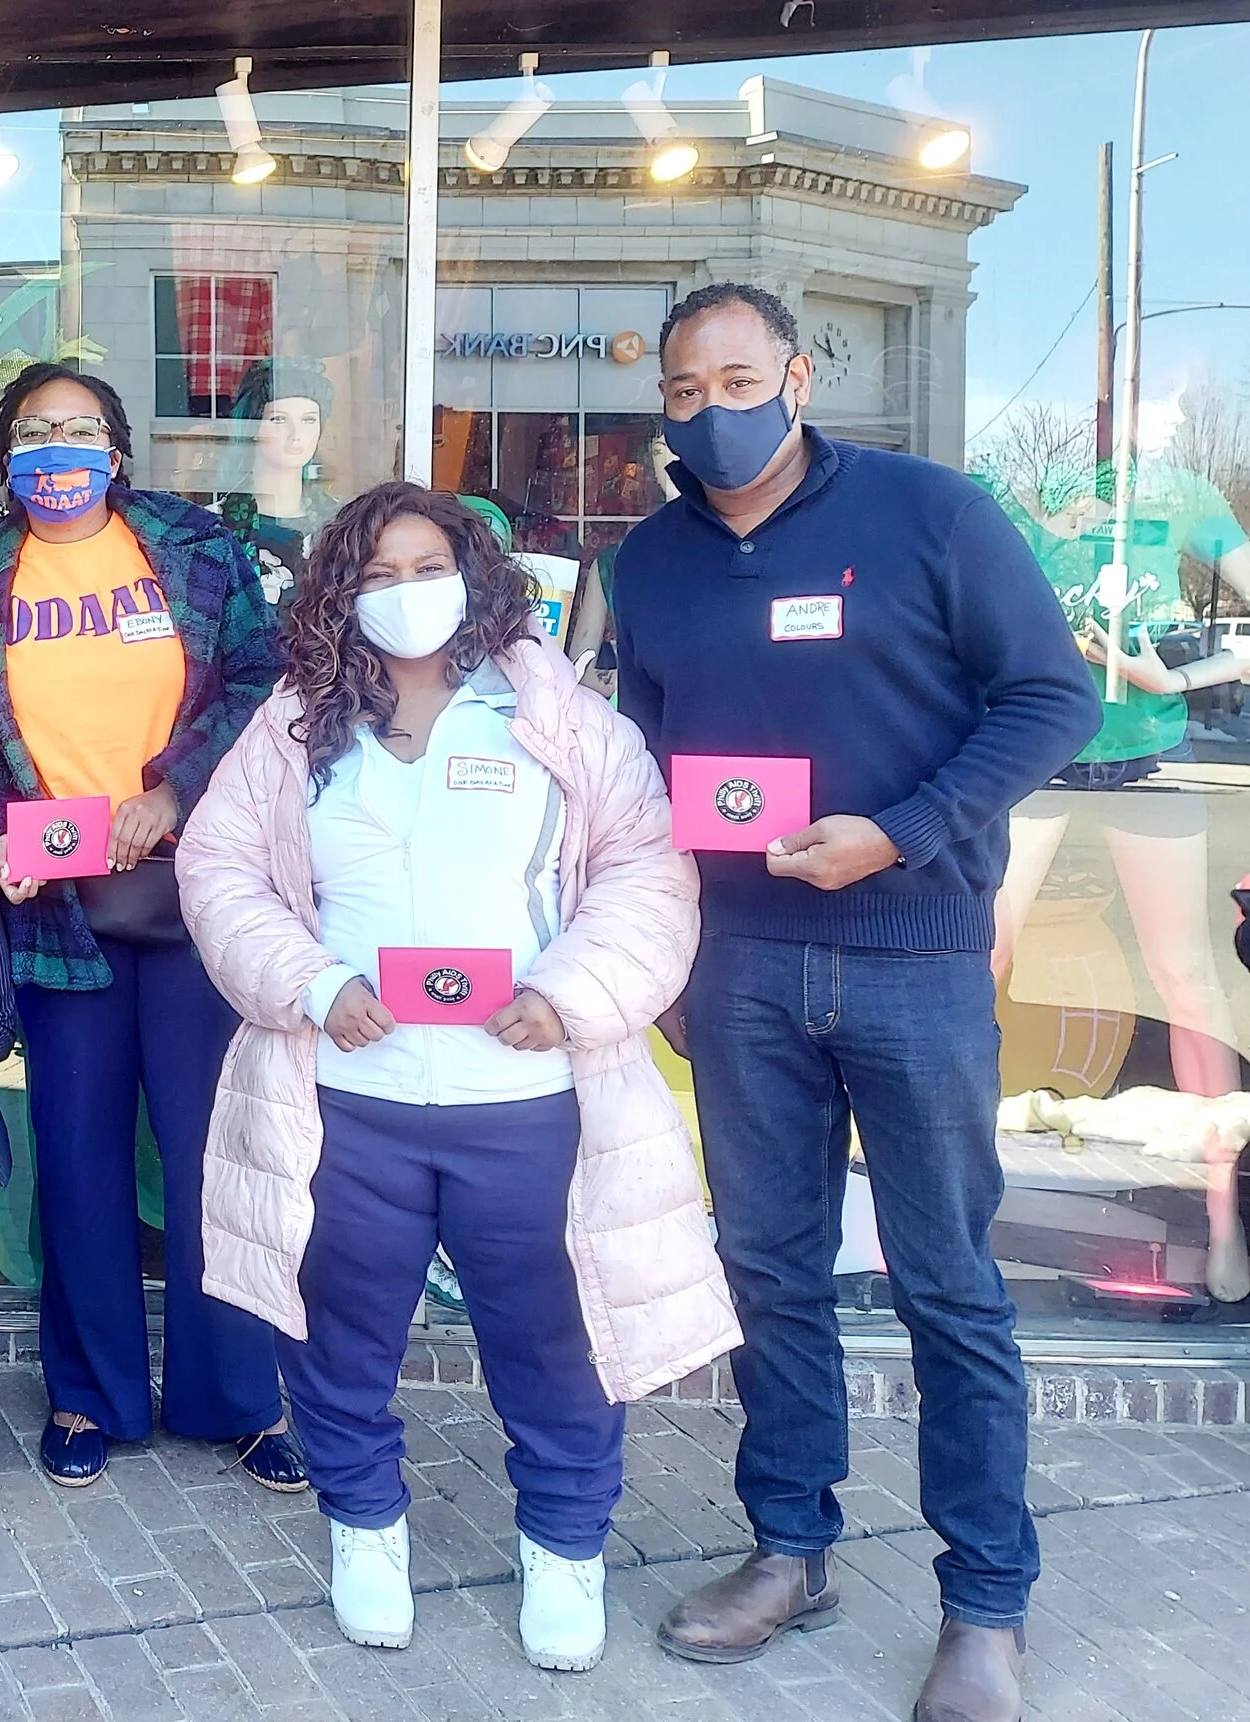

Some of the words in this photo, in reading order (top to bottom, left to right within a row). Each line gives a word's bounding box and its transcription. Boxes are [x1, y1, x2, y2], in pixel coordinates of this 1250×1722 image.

[786, 601, 831, 617] ANDRE
[127, 614, 162, 628] EBONY
[784, 622, 825, 633] COLOURS
[457, 762, 510, 776] SIMONE
